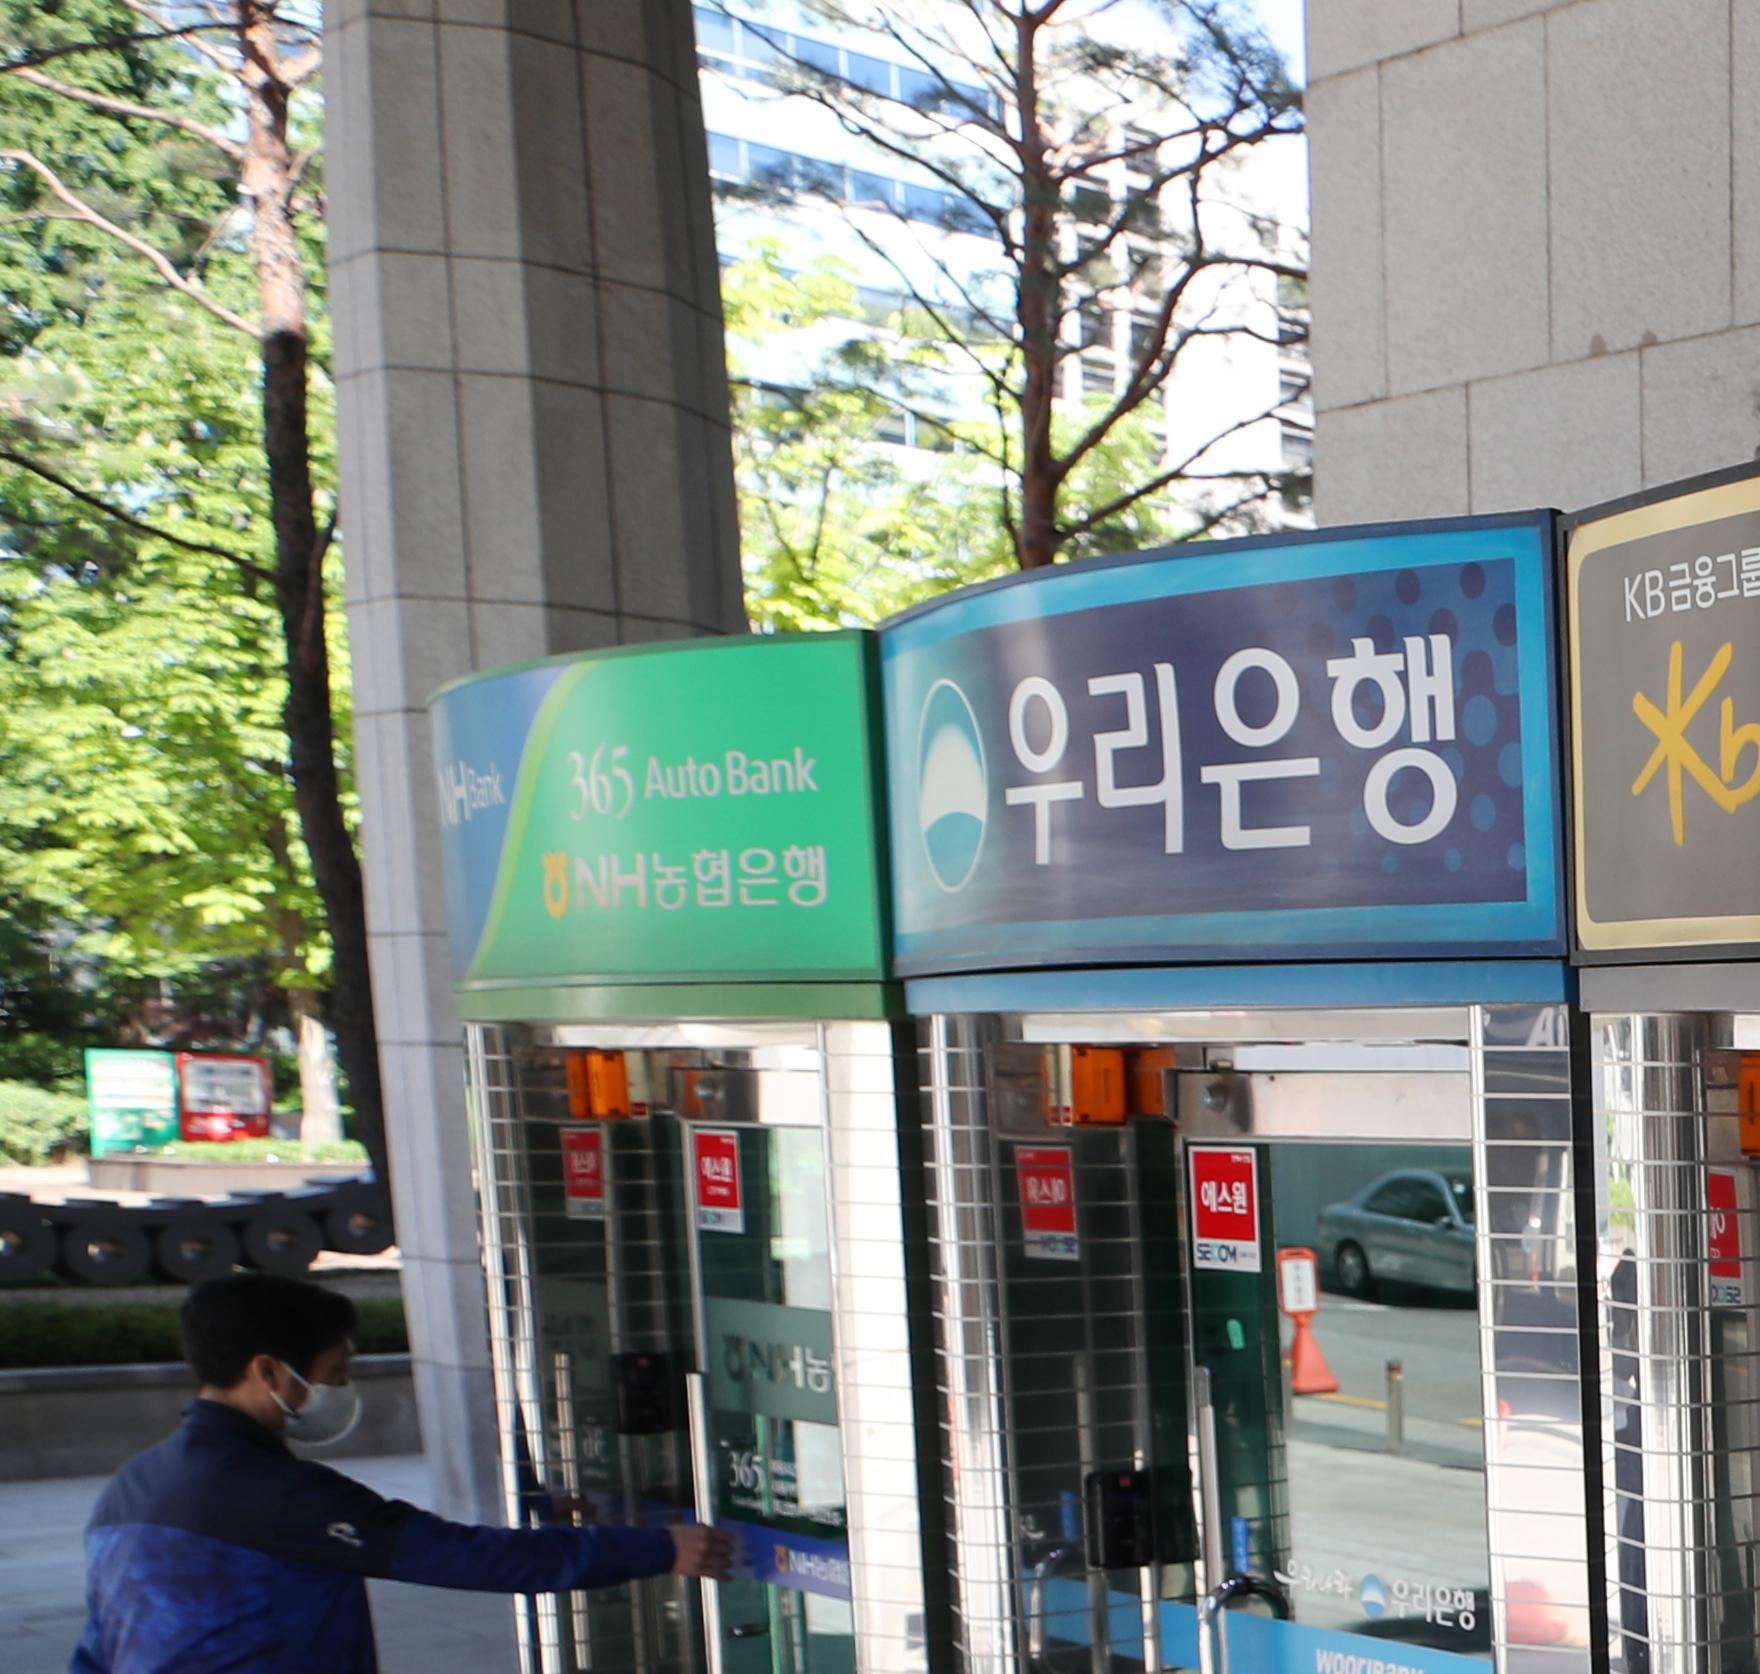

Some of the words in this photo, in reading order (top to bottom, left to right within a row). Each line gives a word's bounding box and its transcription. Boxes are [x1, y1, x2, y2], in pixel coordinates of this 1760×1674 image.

[1004, 633, 1459, 867] 우리은행
[567, 743, 635, 822] 365
[643, 755, 721, 800] Auto
[725, 746, 820, 796] Bank
[574, 845, 829, 911] NH농협은행
[1201, 1180, 1249, 1216] 에스원
[728, 1450, 764, 1494] 365
[1390, 1579, 1477, 1632] 우리은행
